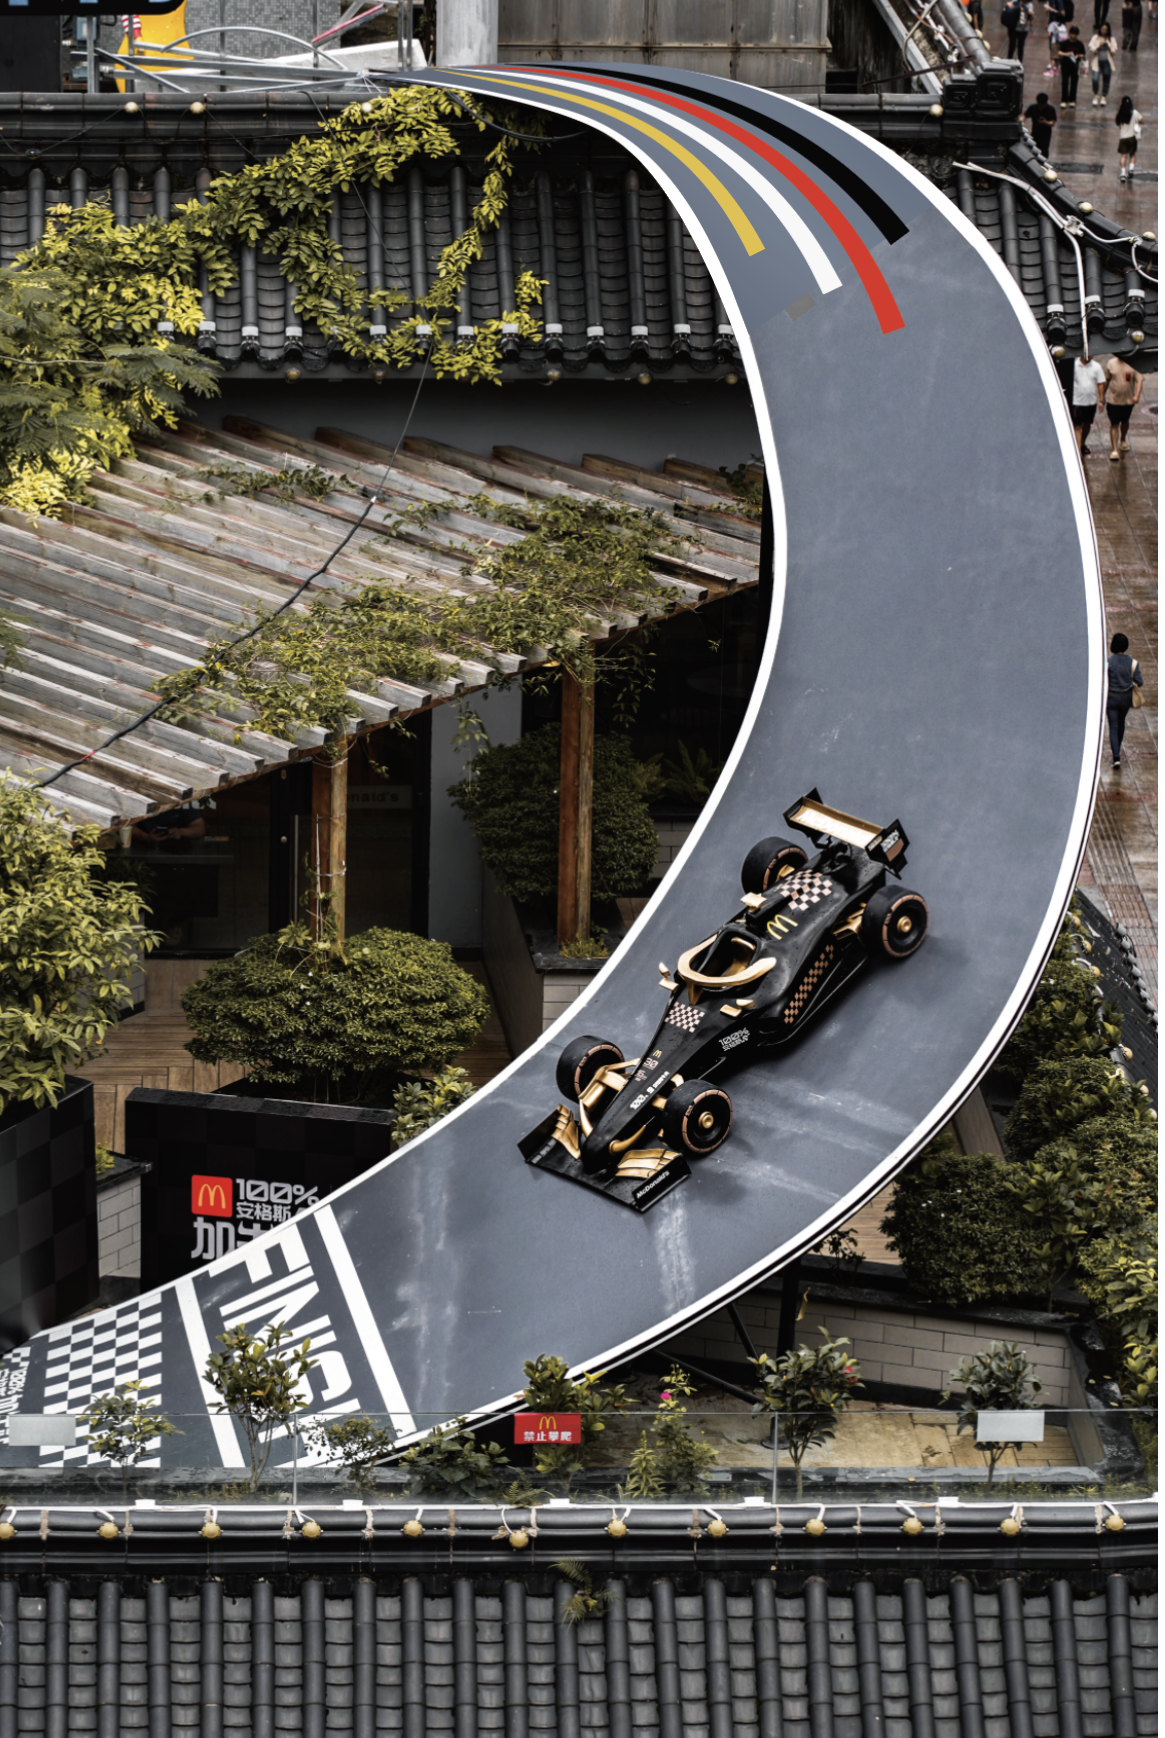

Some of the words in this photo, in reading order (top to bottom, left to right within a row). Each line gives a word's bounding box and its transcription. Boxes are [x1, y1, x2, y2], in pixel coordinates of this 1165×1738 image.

[236, 1178, 320, 1206] 100%
[636, 1170, 670, 1199] McDonald's
[236, 1201, 291, 1222] 安格斯
